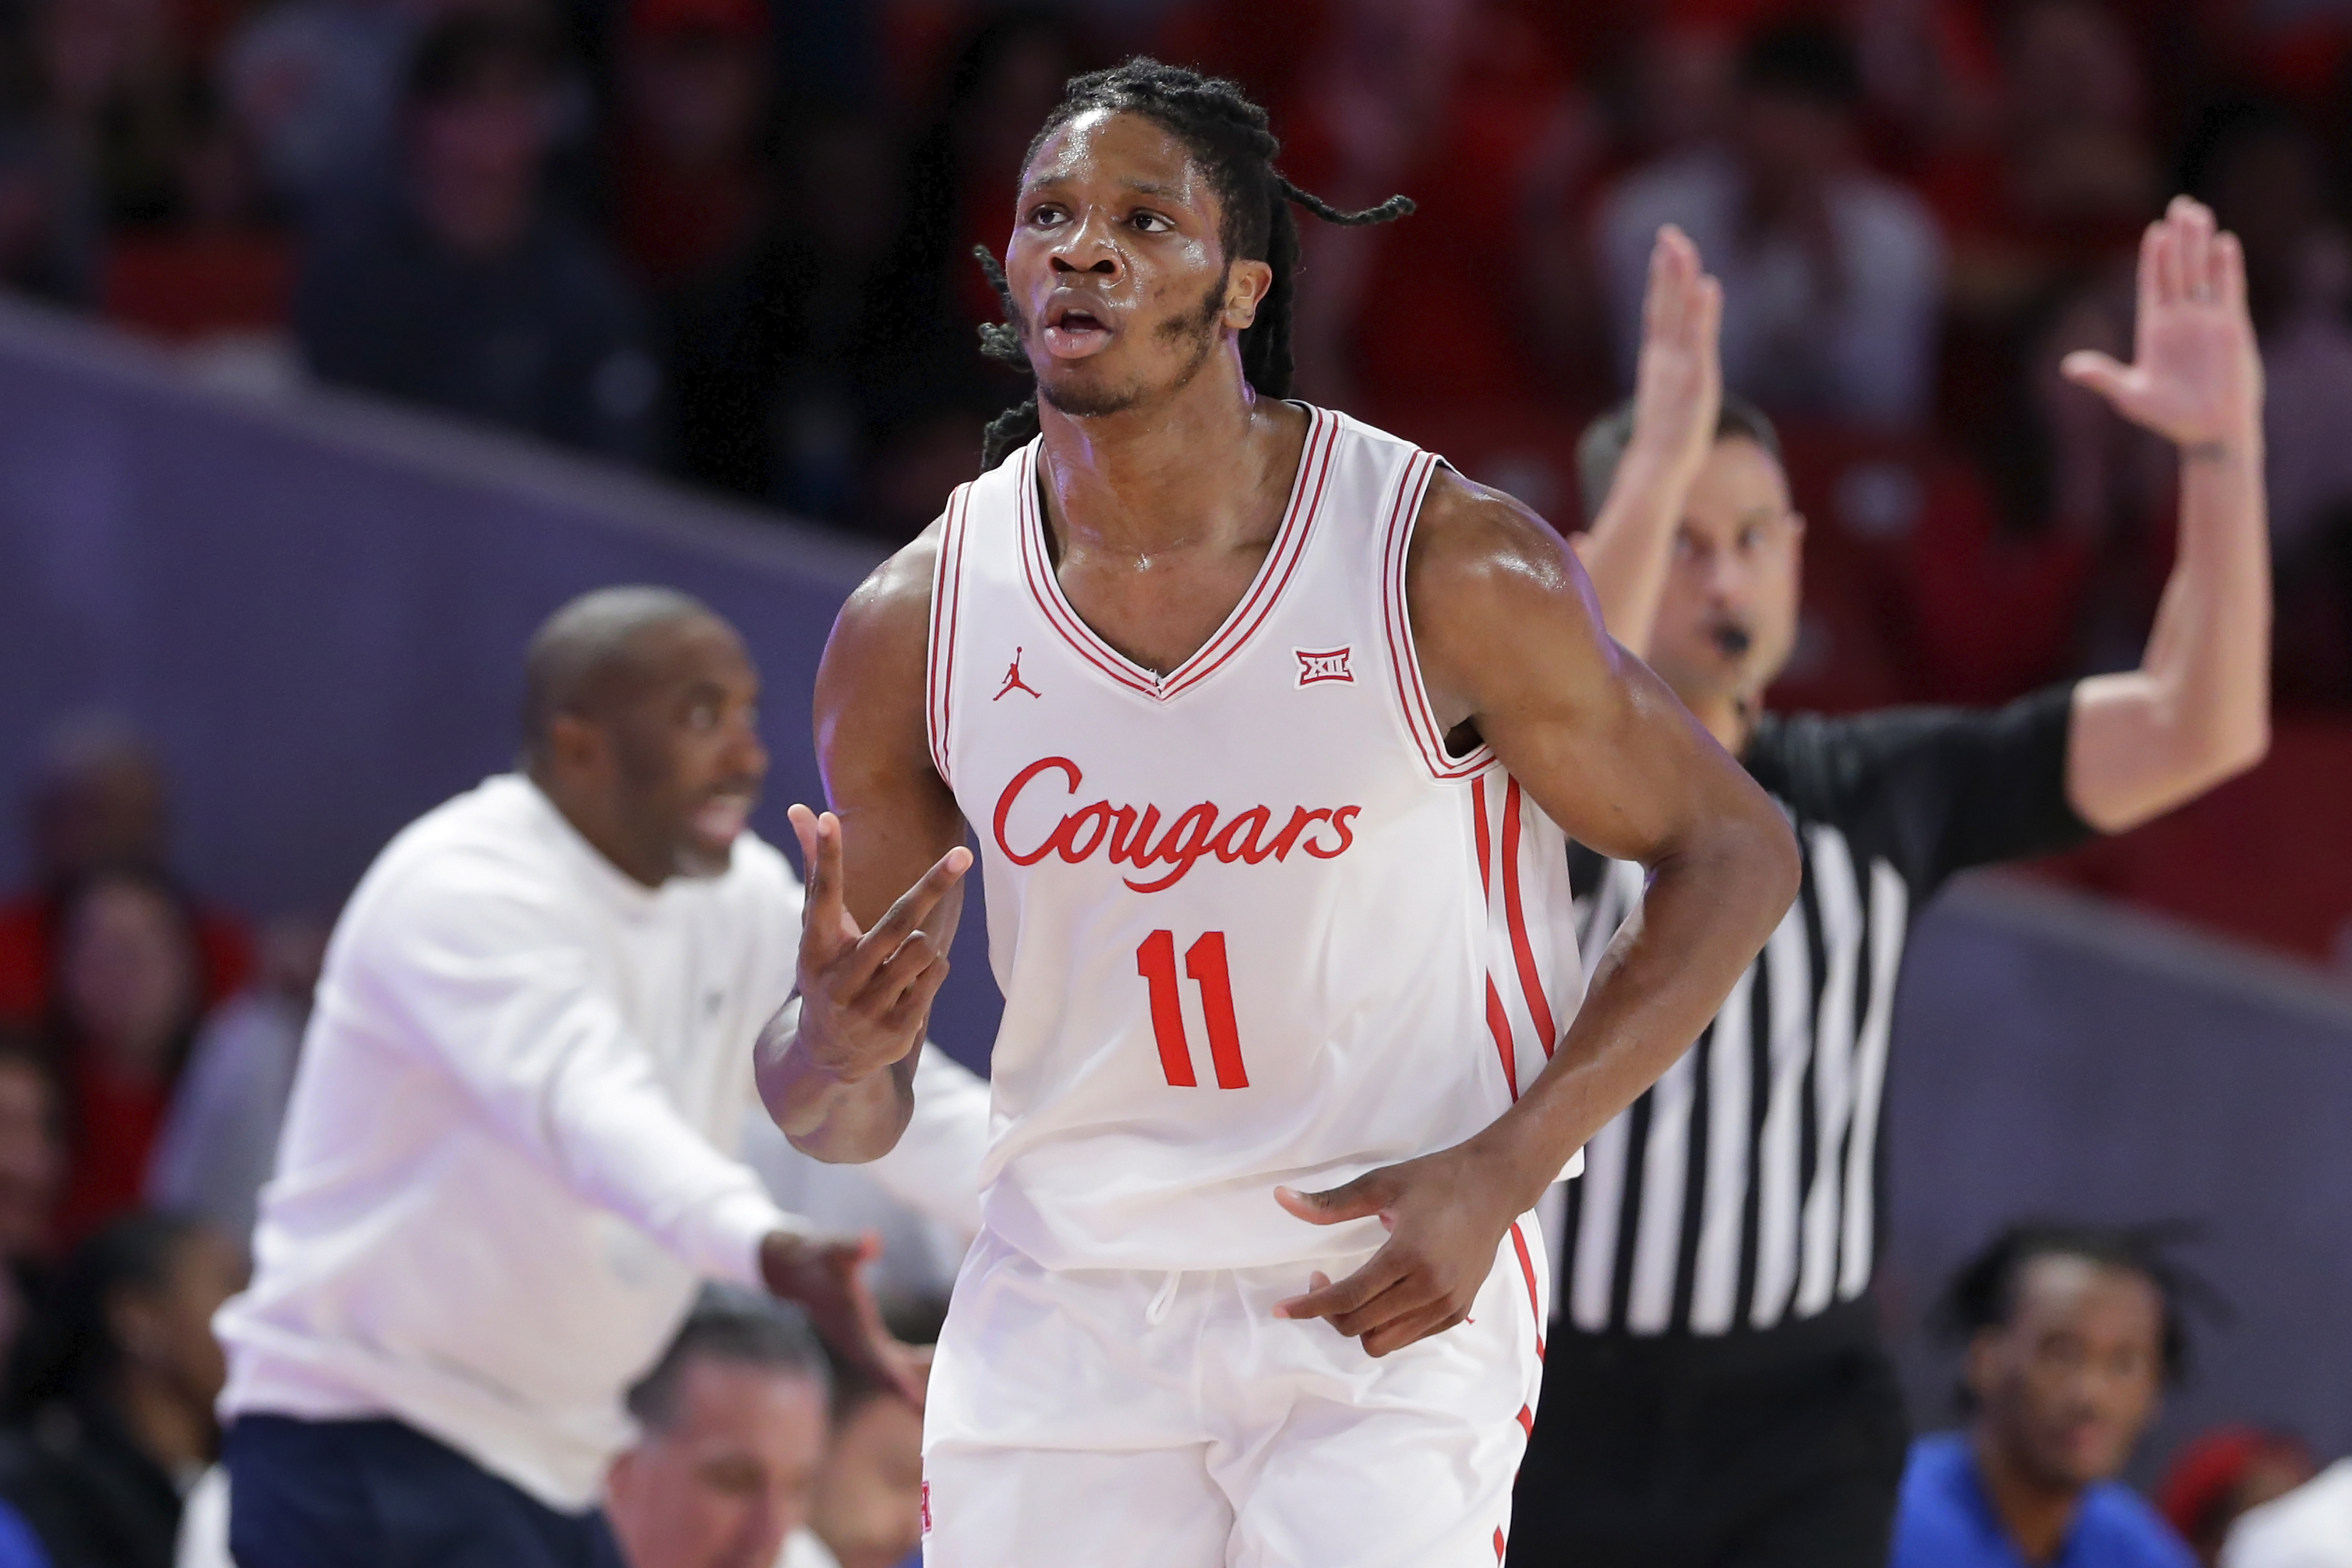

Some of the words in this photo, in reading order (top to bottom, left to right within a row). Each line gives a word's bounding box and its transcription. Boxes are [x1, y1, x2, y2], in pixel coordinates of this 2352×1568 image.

[1299, 651, 1351, 683] XII
[993, 756, 1362, 894] Cougars
[1136, 929, 1250, 1090] 11
